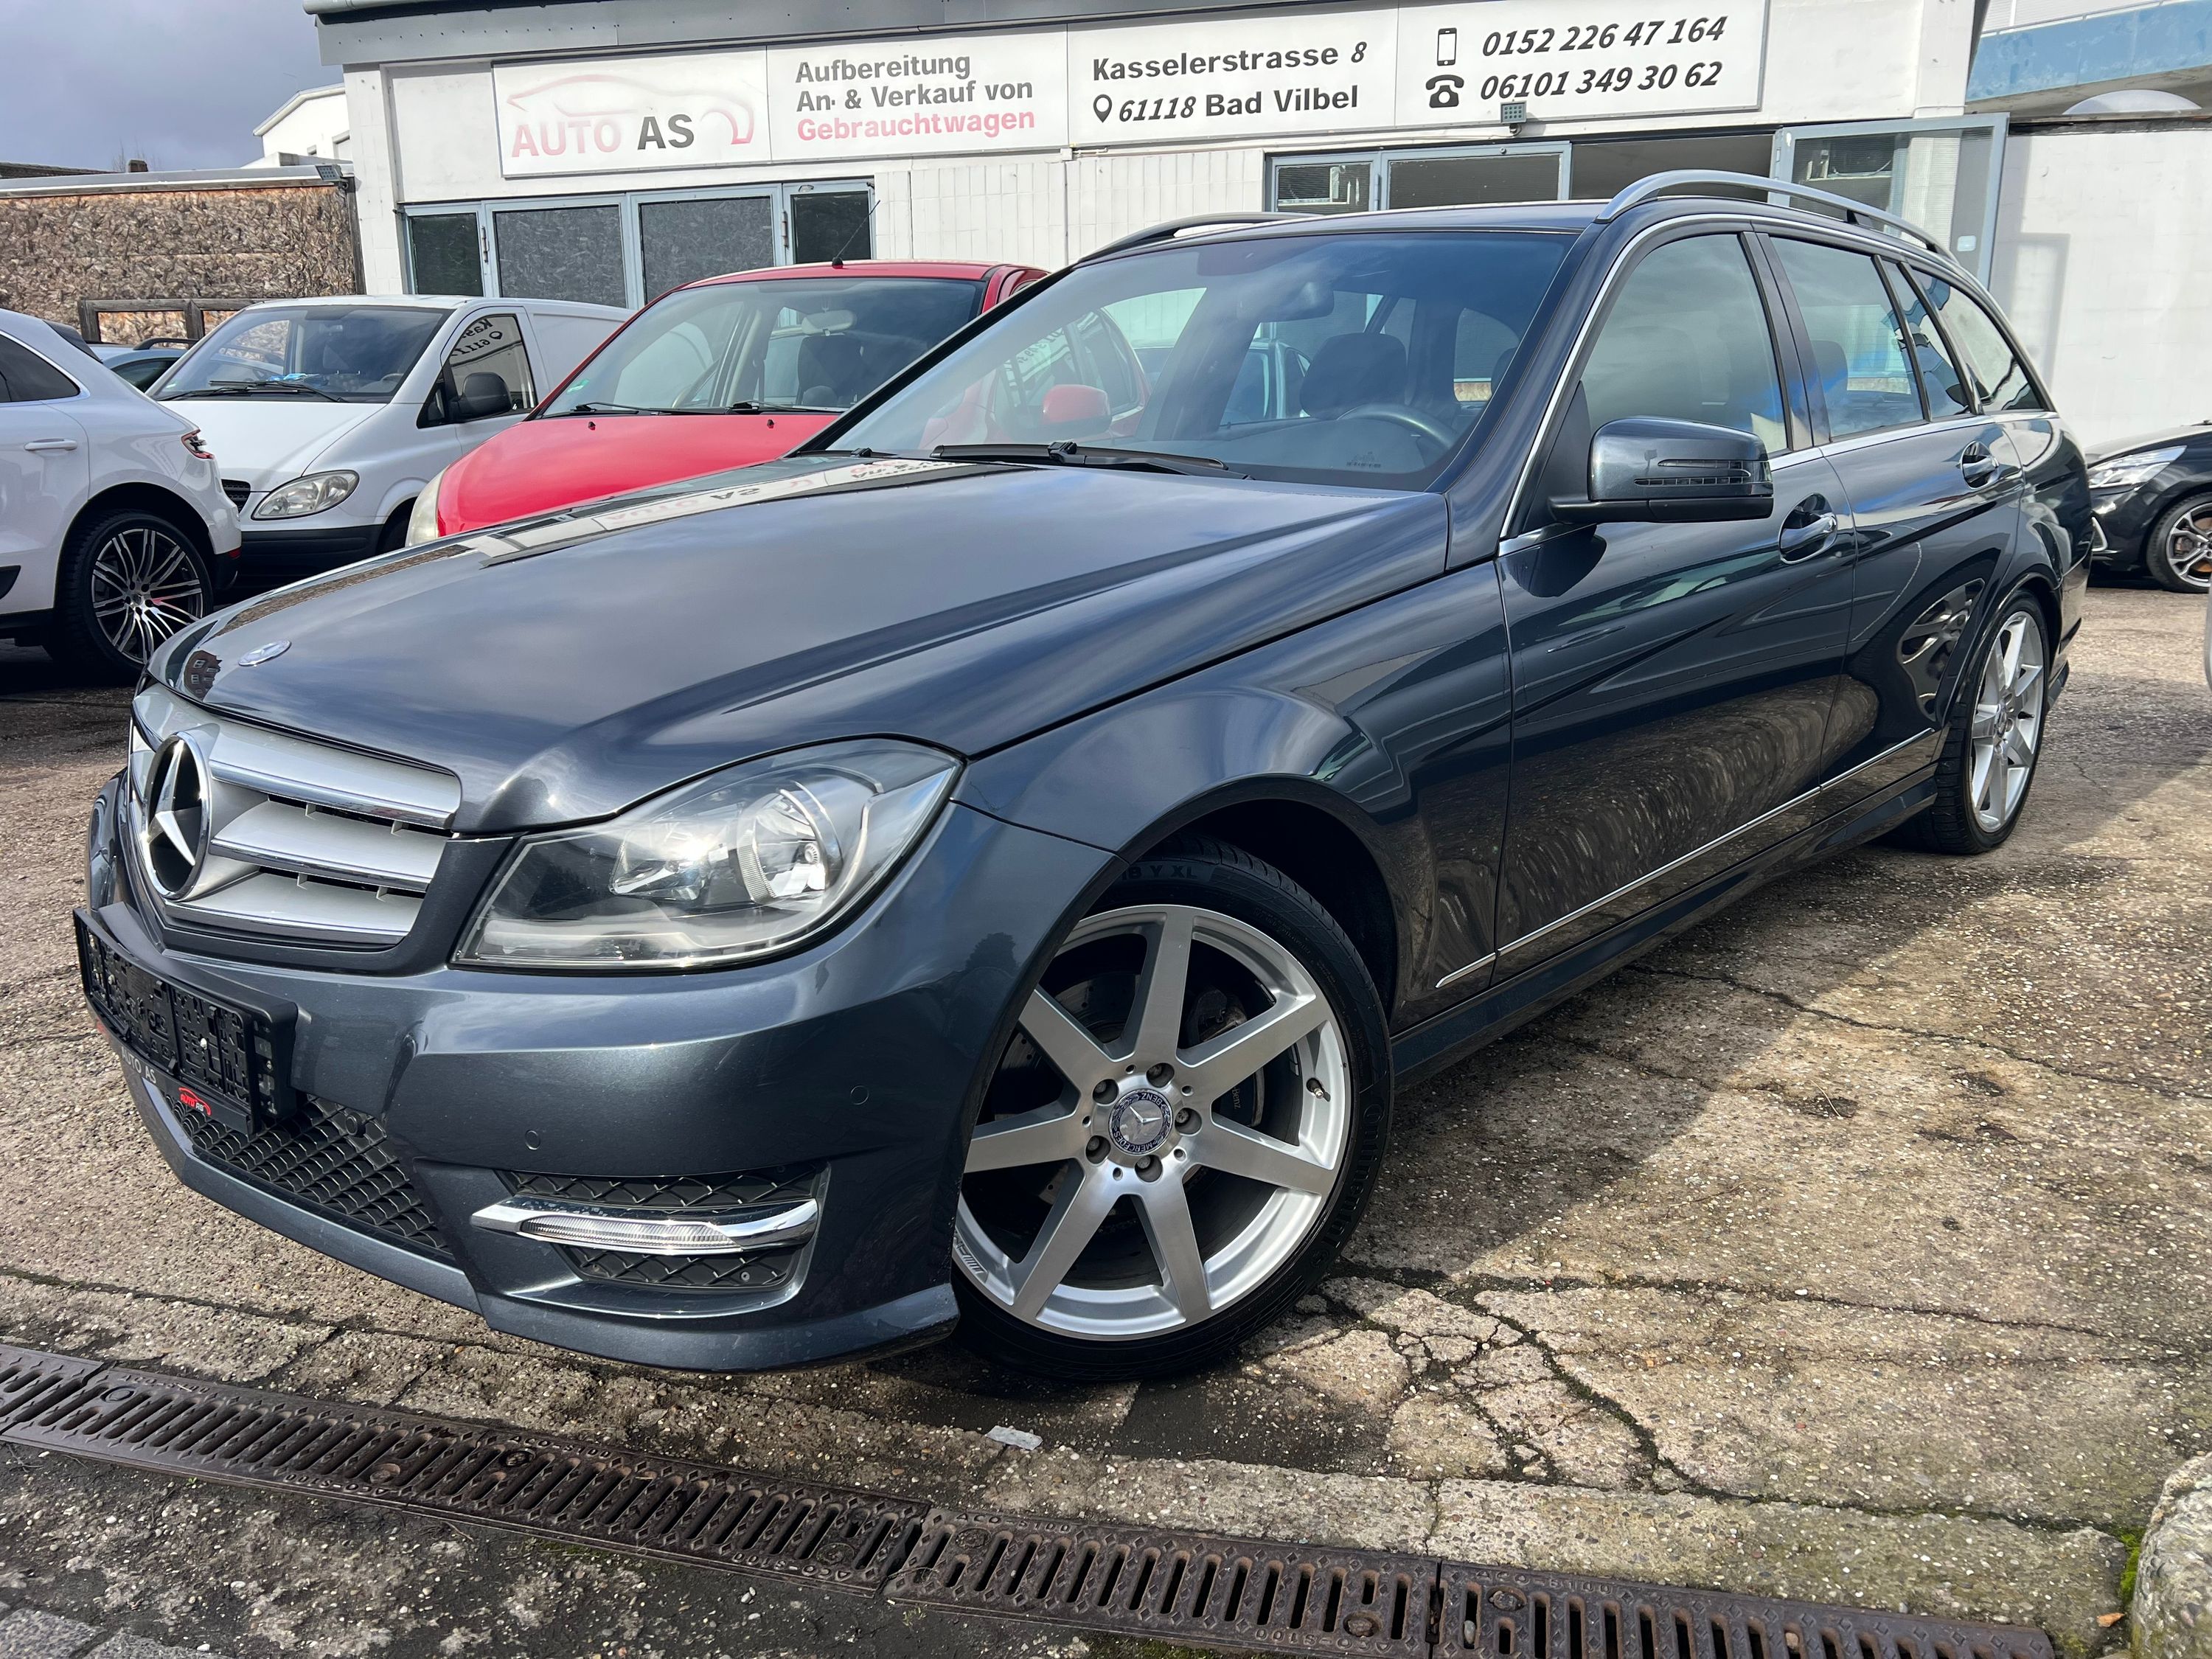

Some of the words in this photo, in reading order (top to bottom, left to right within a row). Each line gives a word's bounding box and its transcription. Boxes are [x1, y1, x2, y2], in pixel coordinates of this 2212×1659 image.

[1482, 27, 1555, 57] 0152
[1559, 23, 1619, 51] 226
[1623, 20, 1666, 46] 47
[1666, 15, 1728, 44] 164
[796, 55, 970, 83] Aufbereitung
[1093, 46, 1338, 81] Kasselerstrasse
[1351, 41, 1367, 63] 8
[845, 88, 862, 109] &
[871, 80, 976, 107] Verkauf
[985, 82, 1032, 101] von
[1481, 71, 1570, 100] 06101
[1575, 66, 1632, 94] 349
[1638, 63, 1677, 90] 30
[1684, 61, 1722, 88] 62
[1119, 96, 1197, 122] 61118
[1206, 91, 1262, 116] Bad
[1273, 85, 1358, 112] Vilbel
[512, 119, 622, 157] AUTO
[637, 114, 695, 150] AS
[797, 111, 1035, 141] Gebrauchtwagen
[121, 1046, 142, 1074] AUTO
[145, 1066, 156, 1084] AS
[1141, 1093, 1163, 1105] BENZ
[1113, 1130, 1153, 1152] MERCEDES
